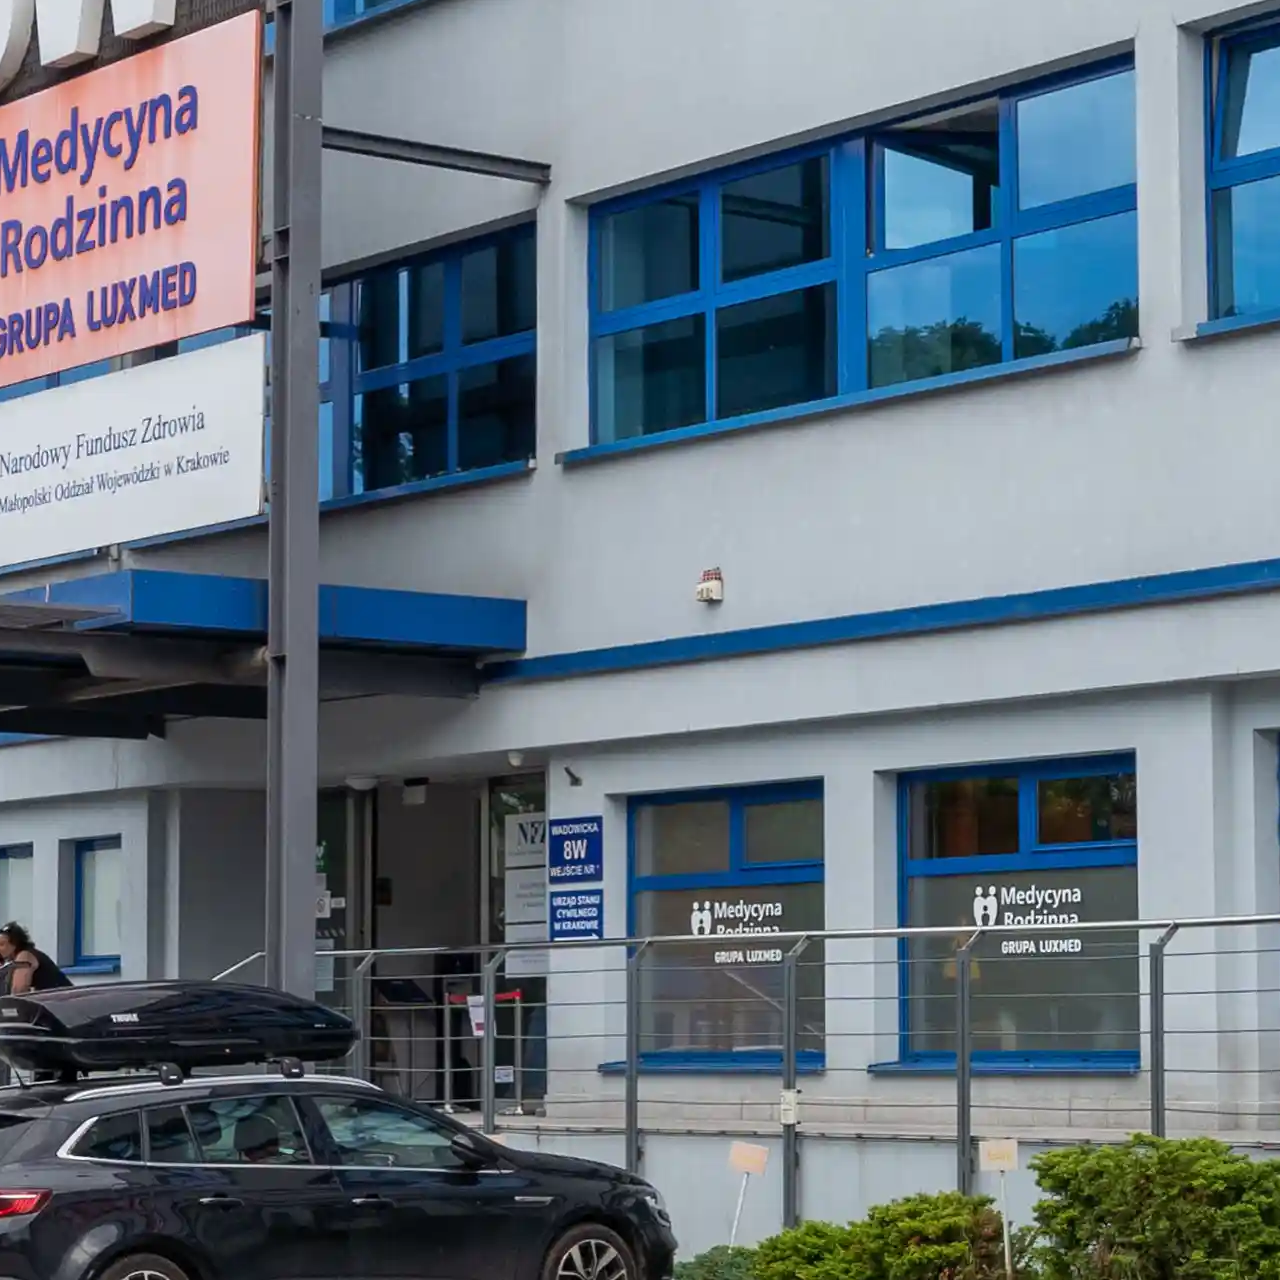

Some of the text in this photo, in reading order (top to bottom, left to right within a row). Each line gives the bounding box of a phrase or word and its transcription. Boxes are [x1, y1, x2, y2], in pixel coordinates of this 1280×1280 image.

[0, 177, 188, 279] Rodzinna
[86, 261, 197, 332] LUXMED
[75, 426, 137, 460] Fundusz
[140, 404, 205, 444] Zdrowia
[54, 474, 94, 503] Oddział
[96, 460, 160, 495] Wojewódzki
[163, 462, 173, 477] w
[176, 445, 230, 476] Krakowie
[551, 821, 599, 836] WADOWICKA
[563, 838, 588, 860] 8W
[577, 894, 600, 906] STANU
[1000, 885, 1081, 908] Medycyna
[556, 909, 598, 920] CYWILNEGO
[714, 899, 783, 922] Medycyna
[562, 919, 599, 930] KRAKOWIE
[714, 948, 783, 964] GRUPA LUXMED
[1001, 938, 1082, 954] GRUPA LUXMED
